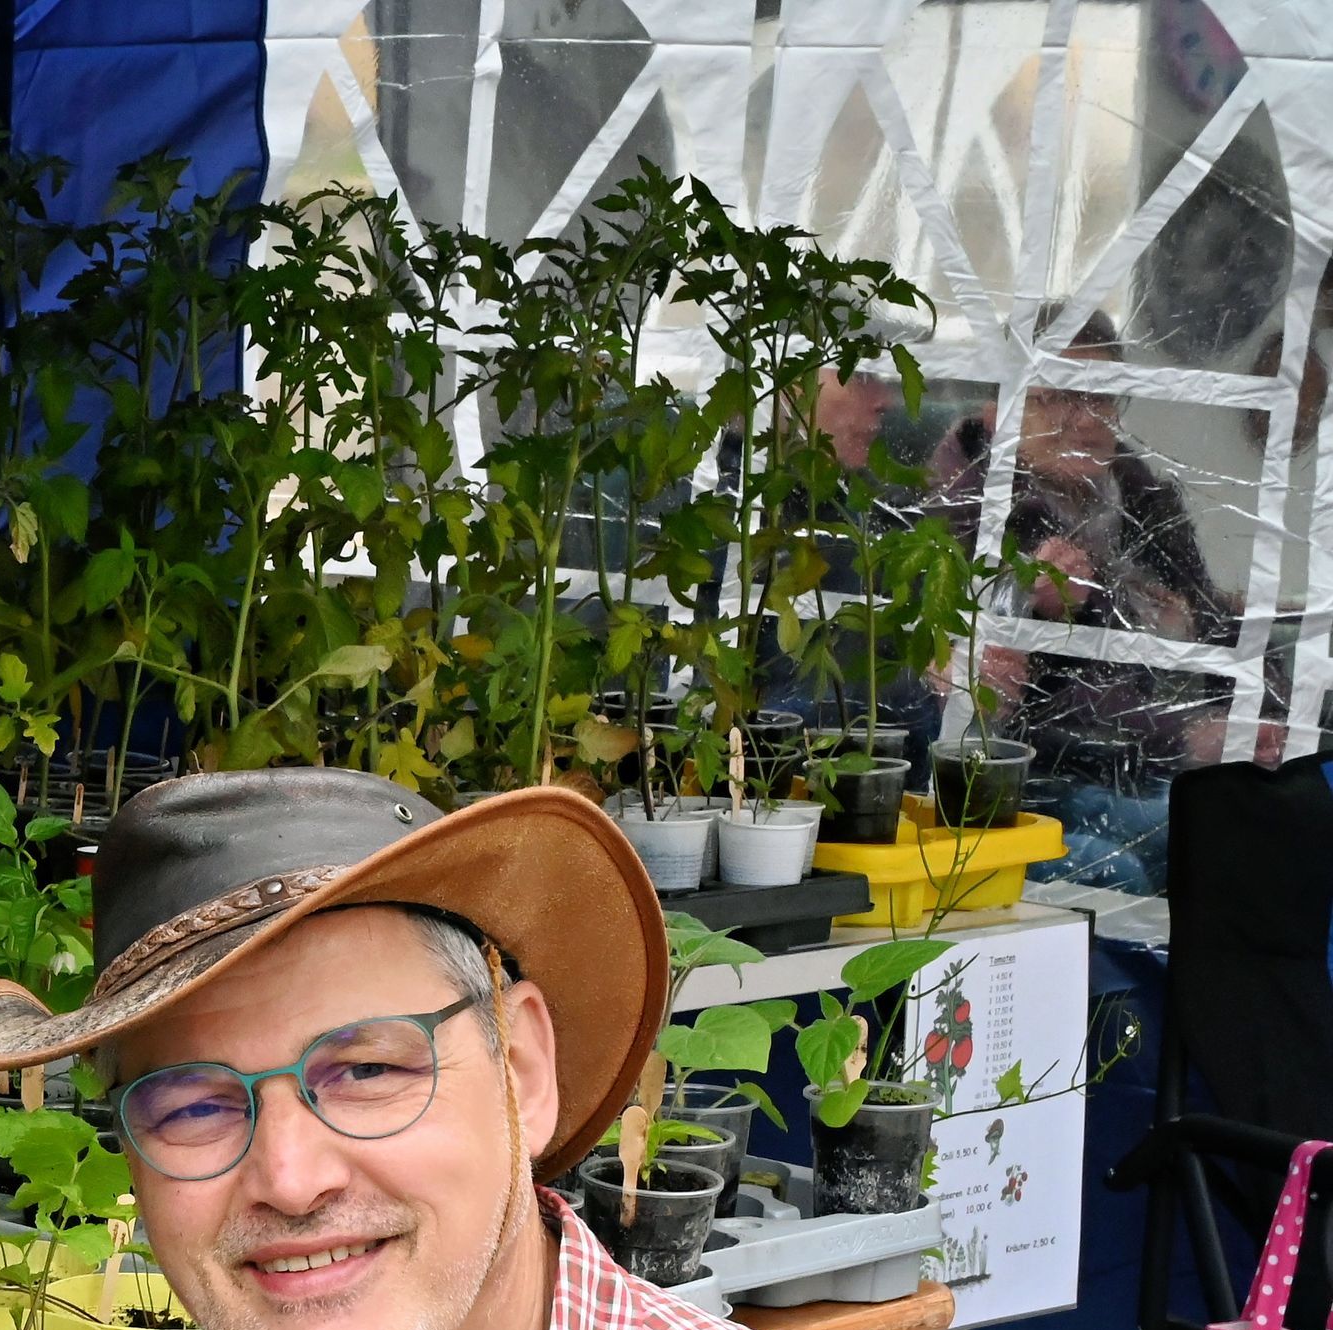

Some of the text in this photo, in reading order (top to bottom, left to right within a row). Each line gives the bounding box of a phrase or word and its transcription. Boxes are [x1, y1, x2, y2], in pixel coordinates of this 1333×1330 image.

[989, 954, 1016, 966] Tomaten
[972, 1146, 978, 1155] €
[966, 1185, 982, 1196] 2,00
[983, 1183, 989, 1192] €
[986, 1201, 992, 1210] €
[1005, 1236, 1056, 1253] Kräuter 2,50 €
